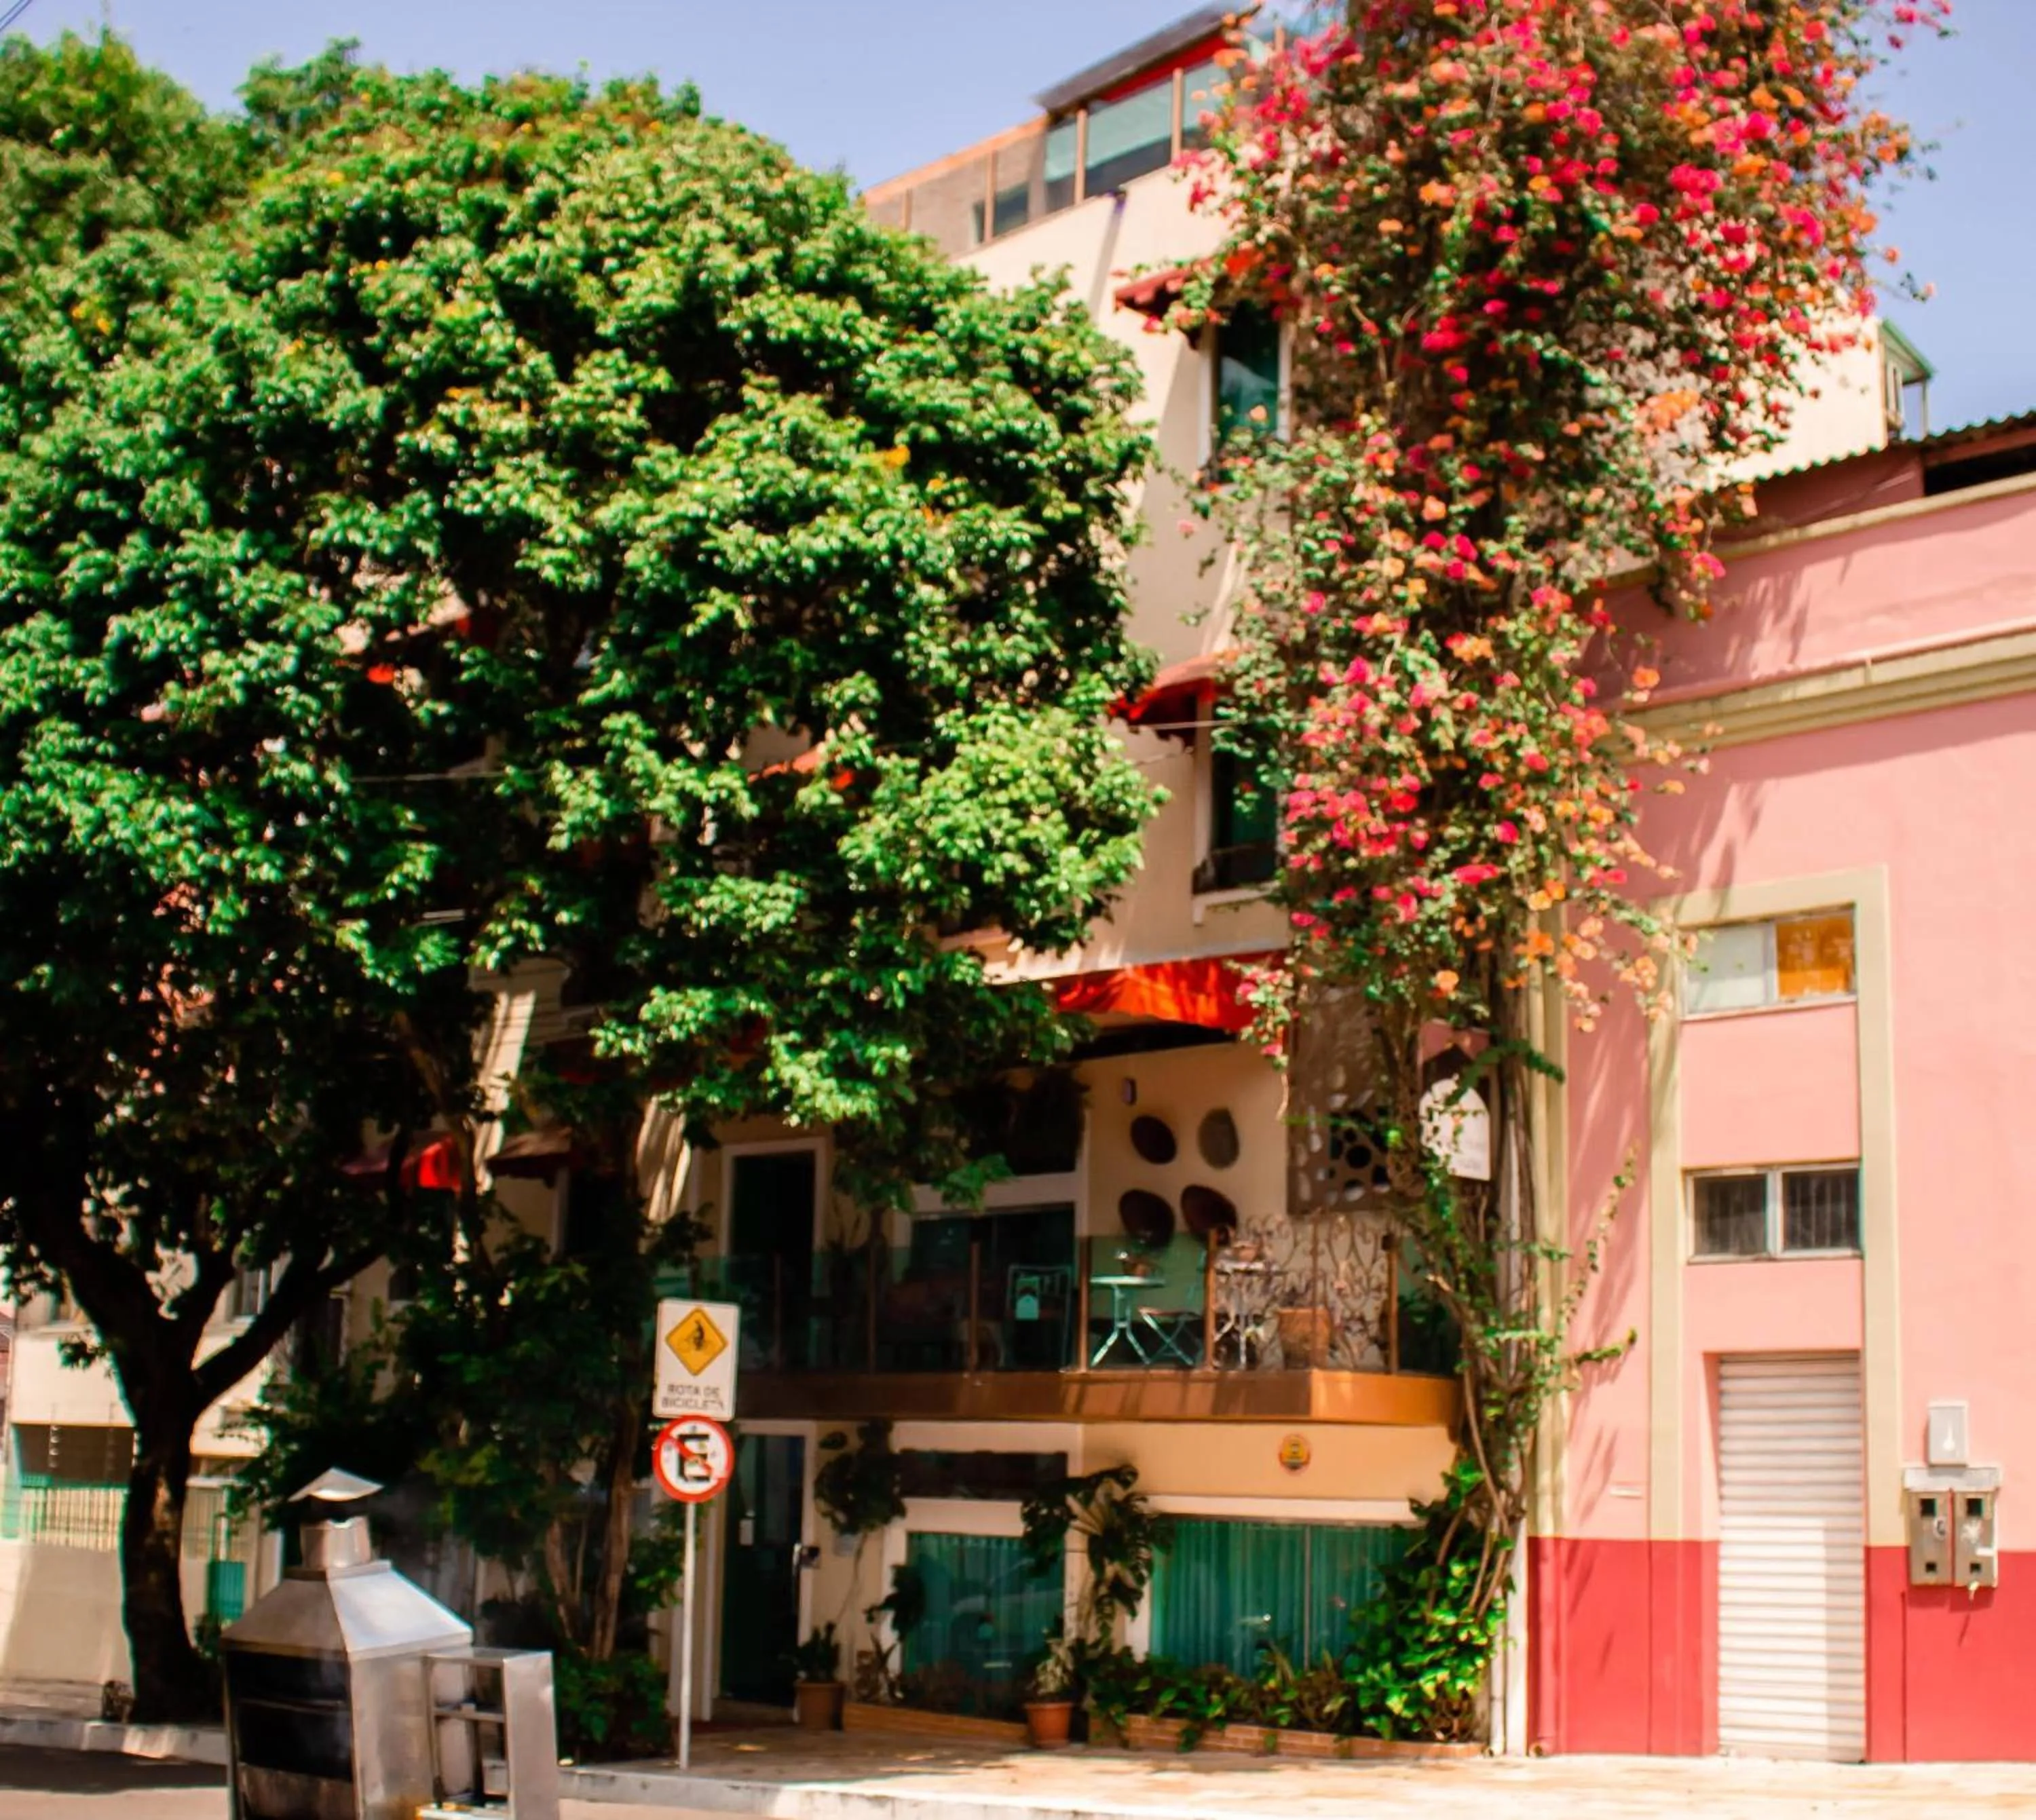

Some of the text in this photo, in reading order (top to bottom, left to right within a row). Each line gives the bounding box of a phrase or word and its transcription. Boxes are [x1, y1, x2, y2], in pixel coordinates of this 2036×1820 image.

[668, 1384, 719, 1398] ROTA DE
[678, 1434, 710, 1482] E
